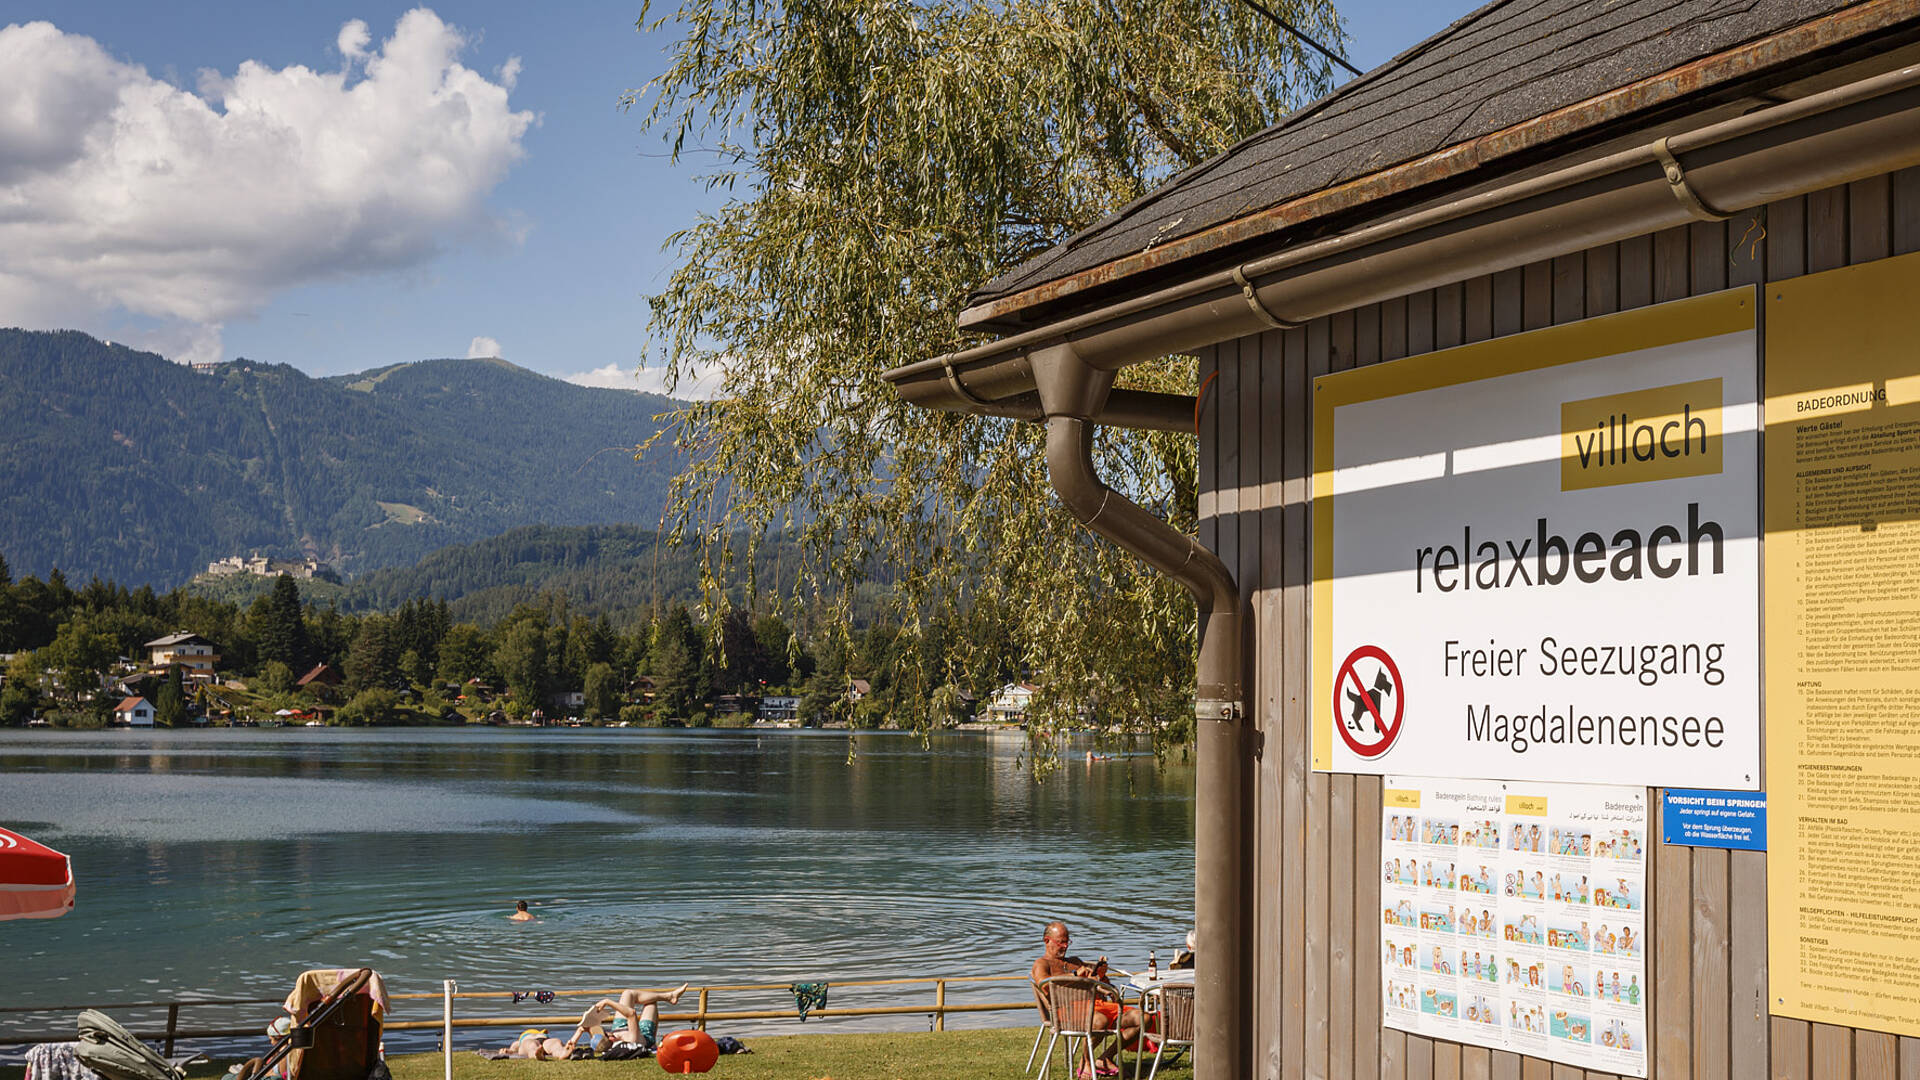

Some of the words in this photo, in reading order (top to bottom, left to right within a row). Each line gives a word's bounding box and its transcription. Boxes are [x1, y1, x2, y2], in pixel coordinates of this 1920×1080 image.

[1797, 389, 1886, 412] BADEORDNUNG
[1576, 404, 1706, 469] villach
[1796, 423, 1818, 434] Werte
[1416, 502, 1725, 593] relaxbeach
[1445, 639, 1527, 677] Freier
[1540, 636, 1725, 686] Seezugang
[1466, 704, 1724, 753] Magdalenensee
[1605, 802, 1643, 813] Baderegeln
[1668, 797, 1704, 805] VORSICHT
[1800, 907, 1845, 917] MELDEPFLICHTEN
[1850, 911, 1918, 924] HILFELEISTUNGSPFLICHT
[1800, 936, 1829, 945] SONSTIGES
